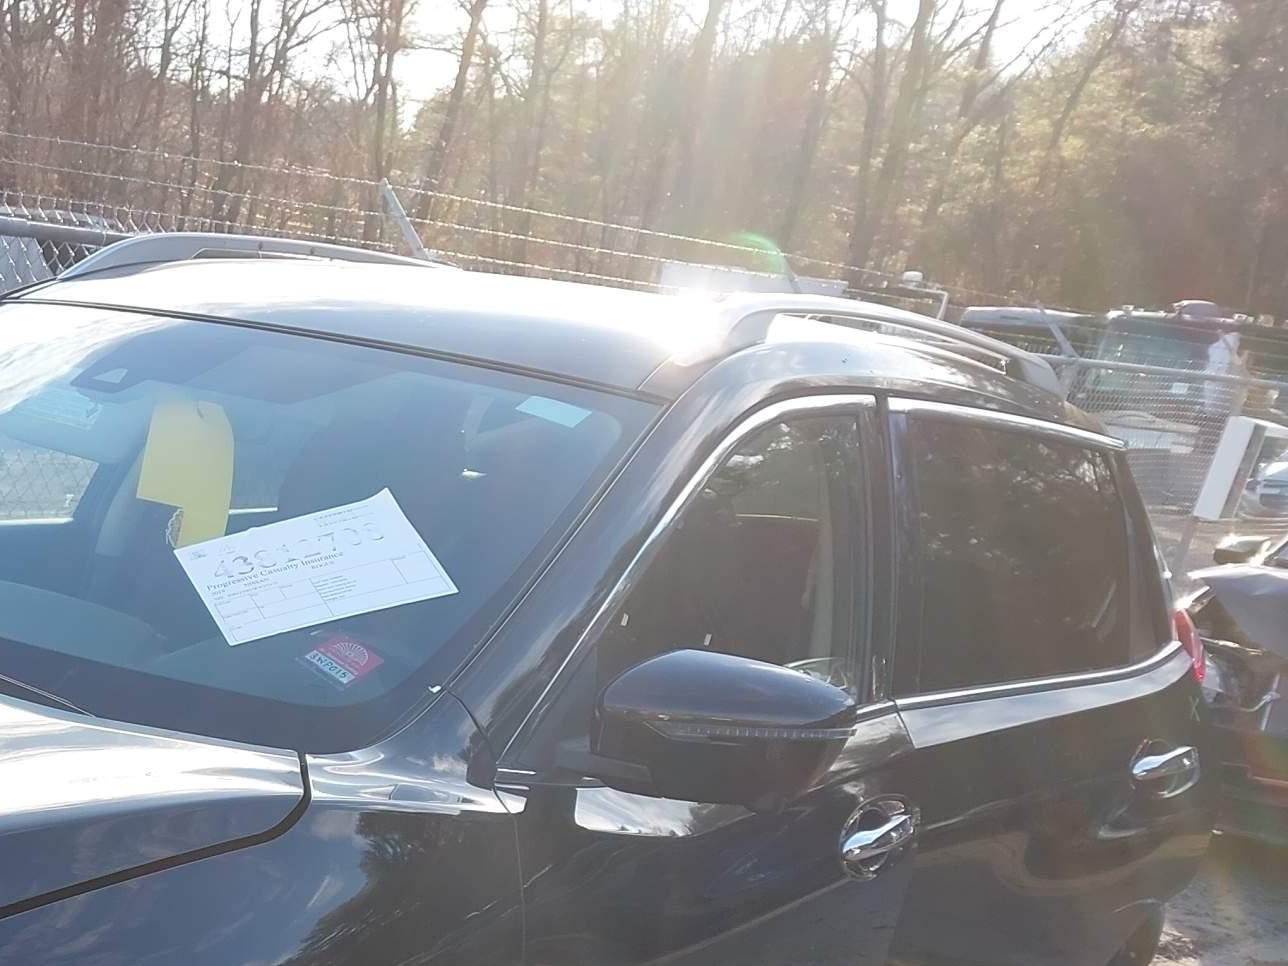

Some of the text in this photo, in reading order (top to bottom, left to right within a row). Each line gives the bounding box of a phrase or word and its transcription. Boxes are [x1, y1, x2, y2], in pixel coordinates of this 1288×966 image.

[206, 572, 260, 591] Progressive
[260, 562, 299, 577] Casualty
[300, 551, 345, 568] Insurance
